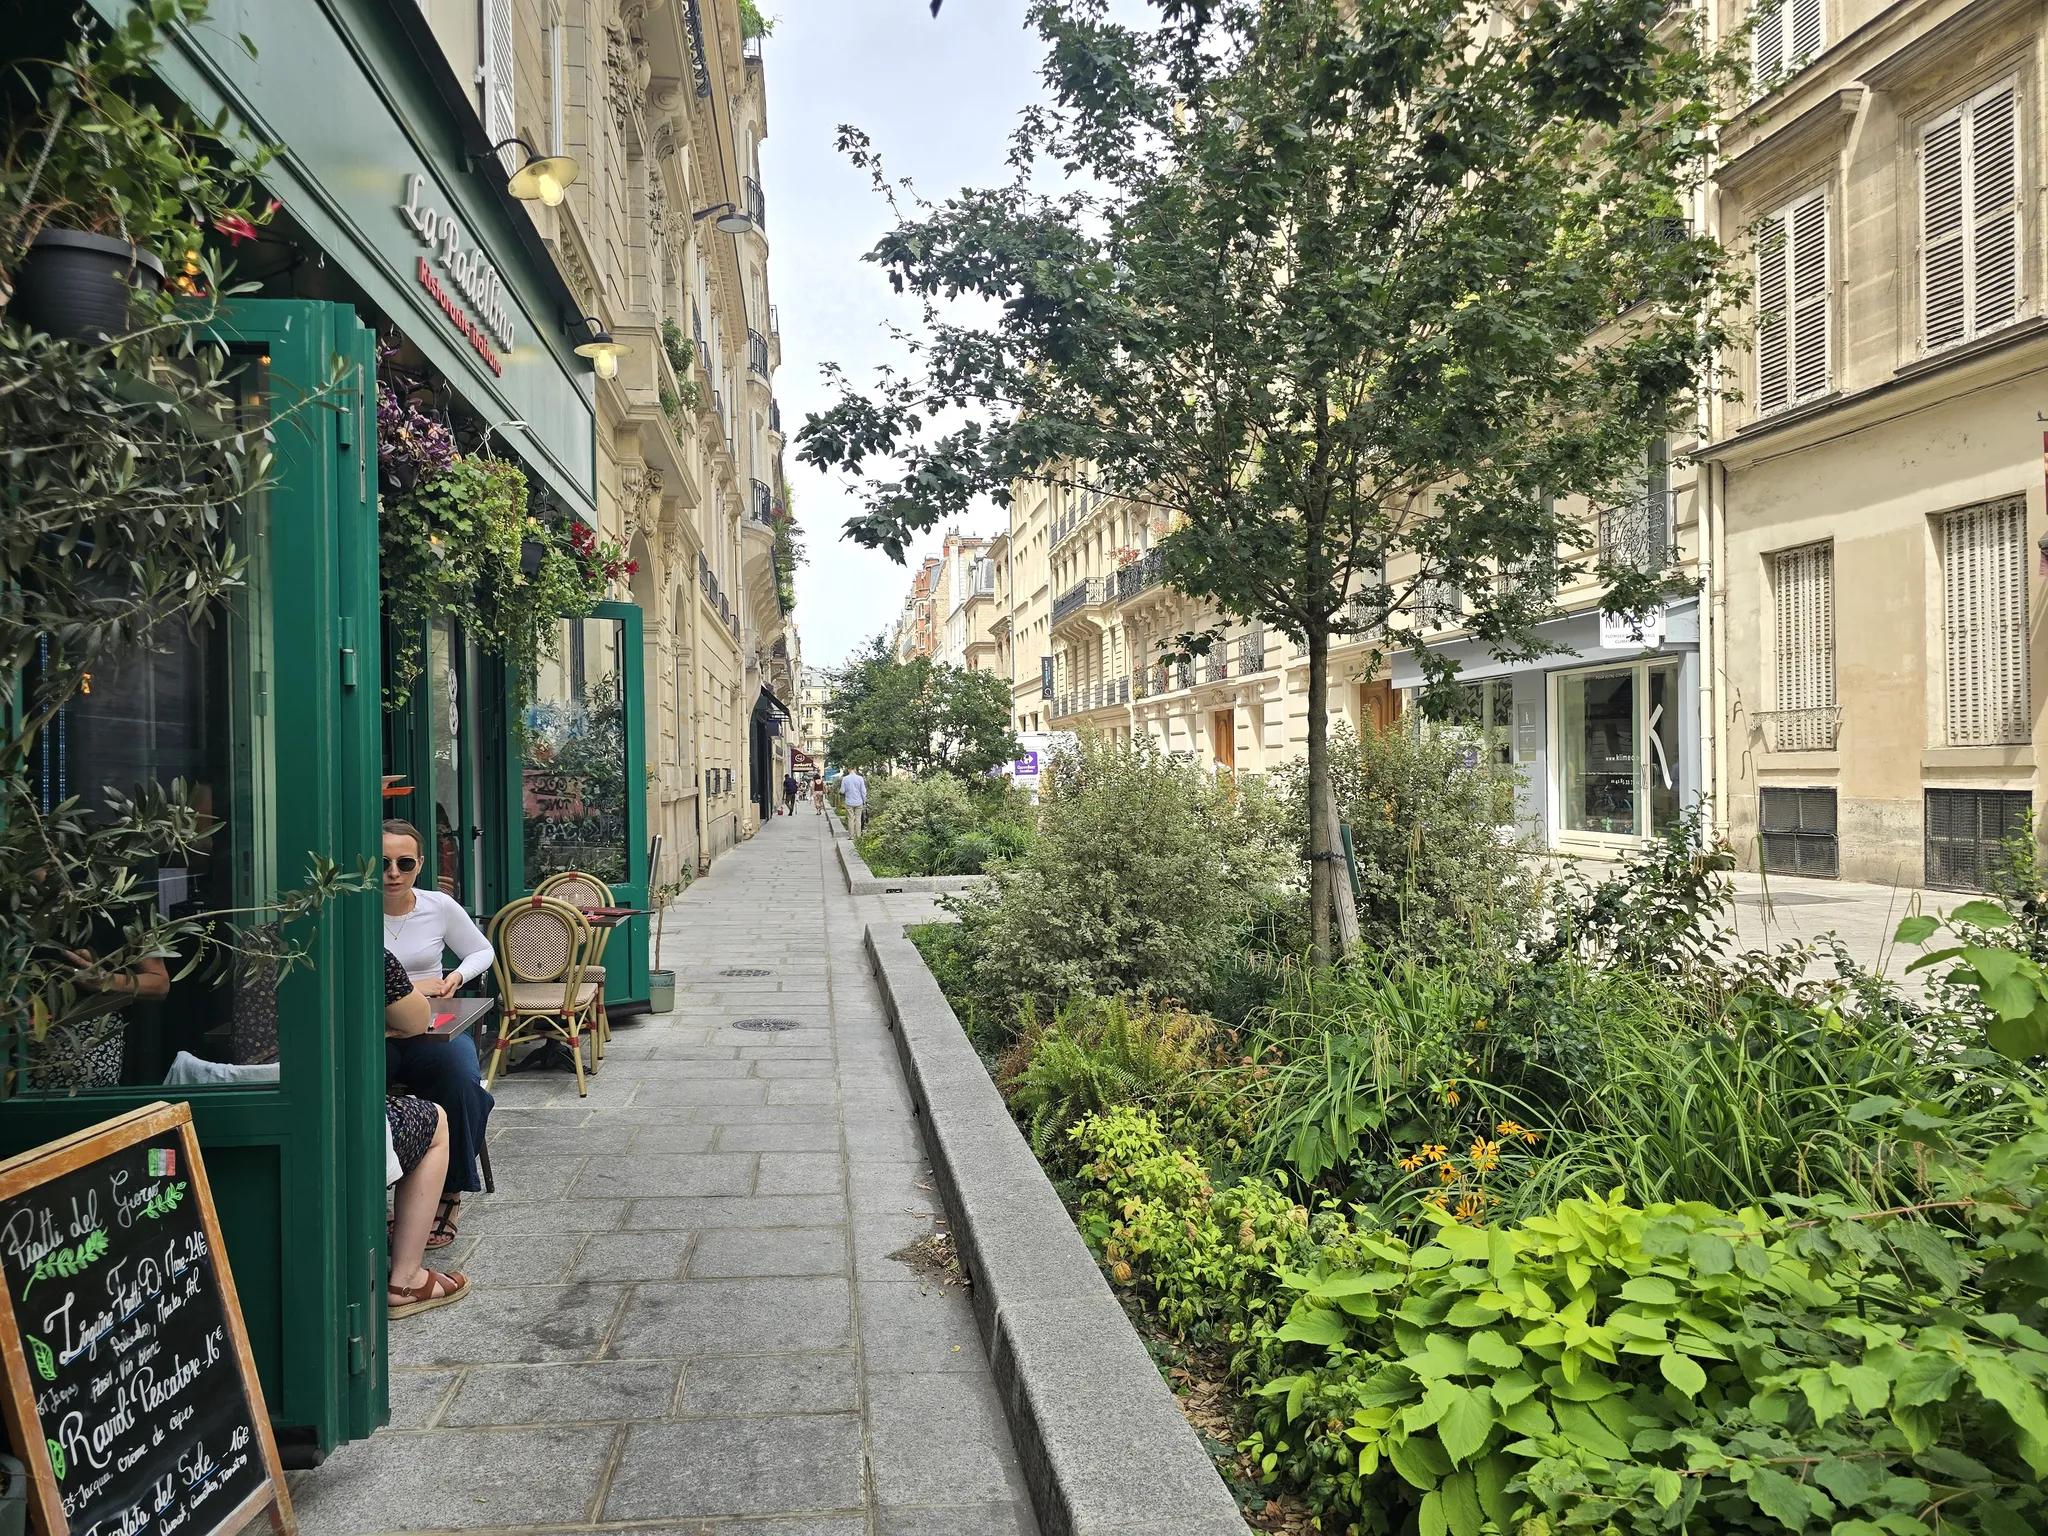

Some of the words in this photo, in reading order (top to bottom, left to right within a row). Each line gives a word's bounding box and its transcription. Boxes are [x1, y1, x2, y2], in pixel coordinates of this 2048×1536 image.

[400, 173, 438, 248] La
[438, 216, 515, 354] Padellina
[418, 256, 470, 338] Ristorante
[469, 322, 503, 378] italiano
[1, 1207, 64, 1270] Piatti
[70, 1189, 103, 1237] del
[110, 1170, 161, 1228] Giorno
[44, 1292, 114, 1364] Linguine
[138, 1257, 162, 1296] Di
[59, 1387, 135, 1469] Ravioli
[130, 1354, 201, 1412] Pescatore
[153, 1425, 165, 1447] de
[154, 1473, 176, 1513] del
[178, 1441, 214, 1486] Sole
